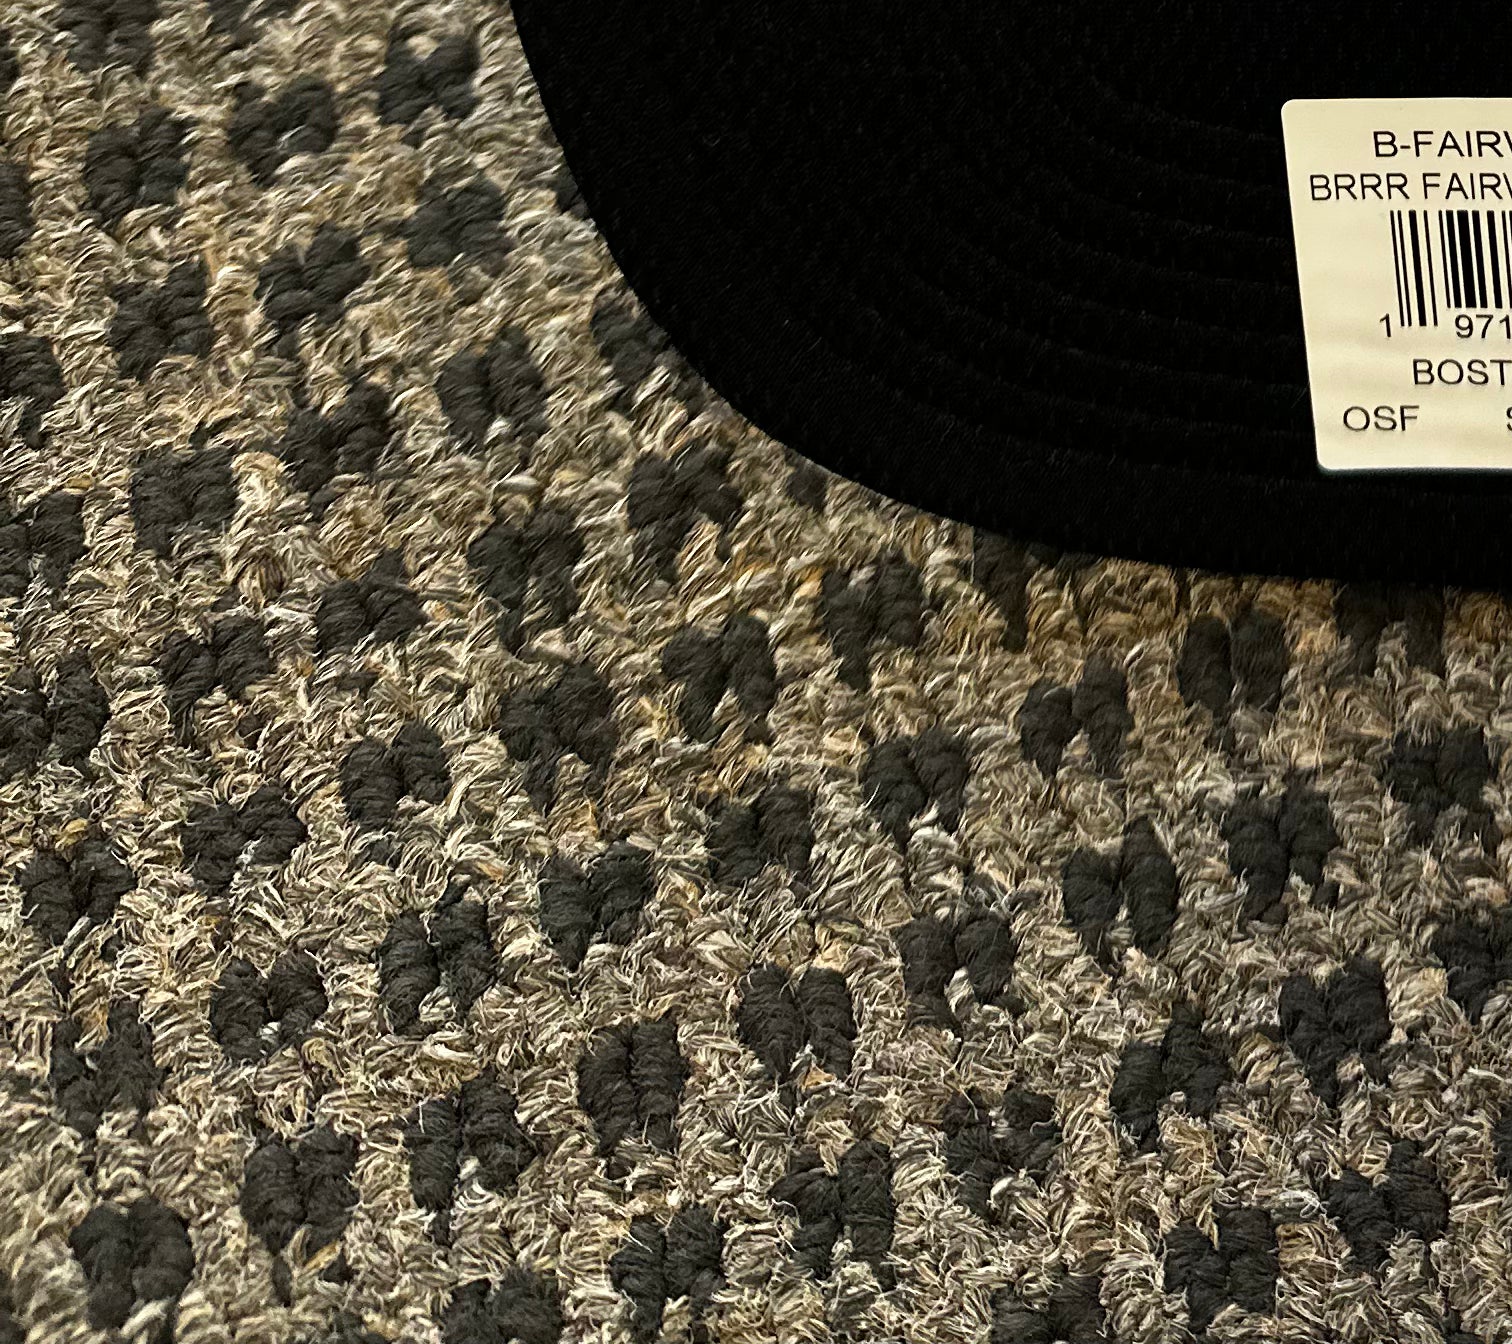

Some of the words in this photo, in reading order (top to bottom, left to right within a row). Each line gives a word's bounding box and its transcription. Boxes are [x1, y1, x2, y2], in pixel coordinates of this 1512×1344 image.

[1309, 173, 1410, 201] BRRR
[1379, 313, 1392, 338] 1
[1342, 405, 1420, 433] OSF
